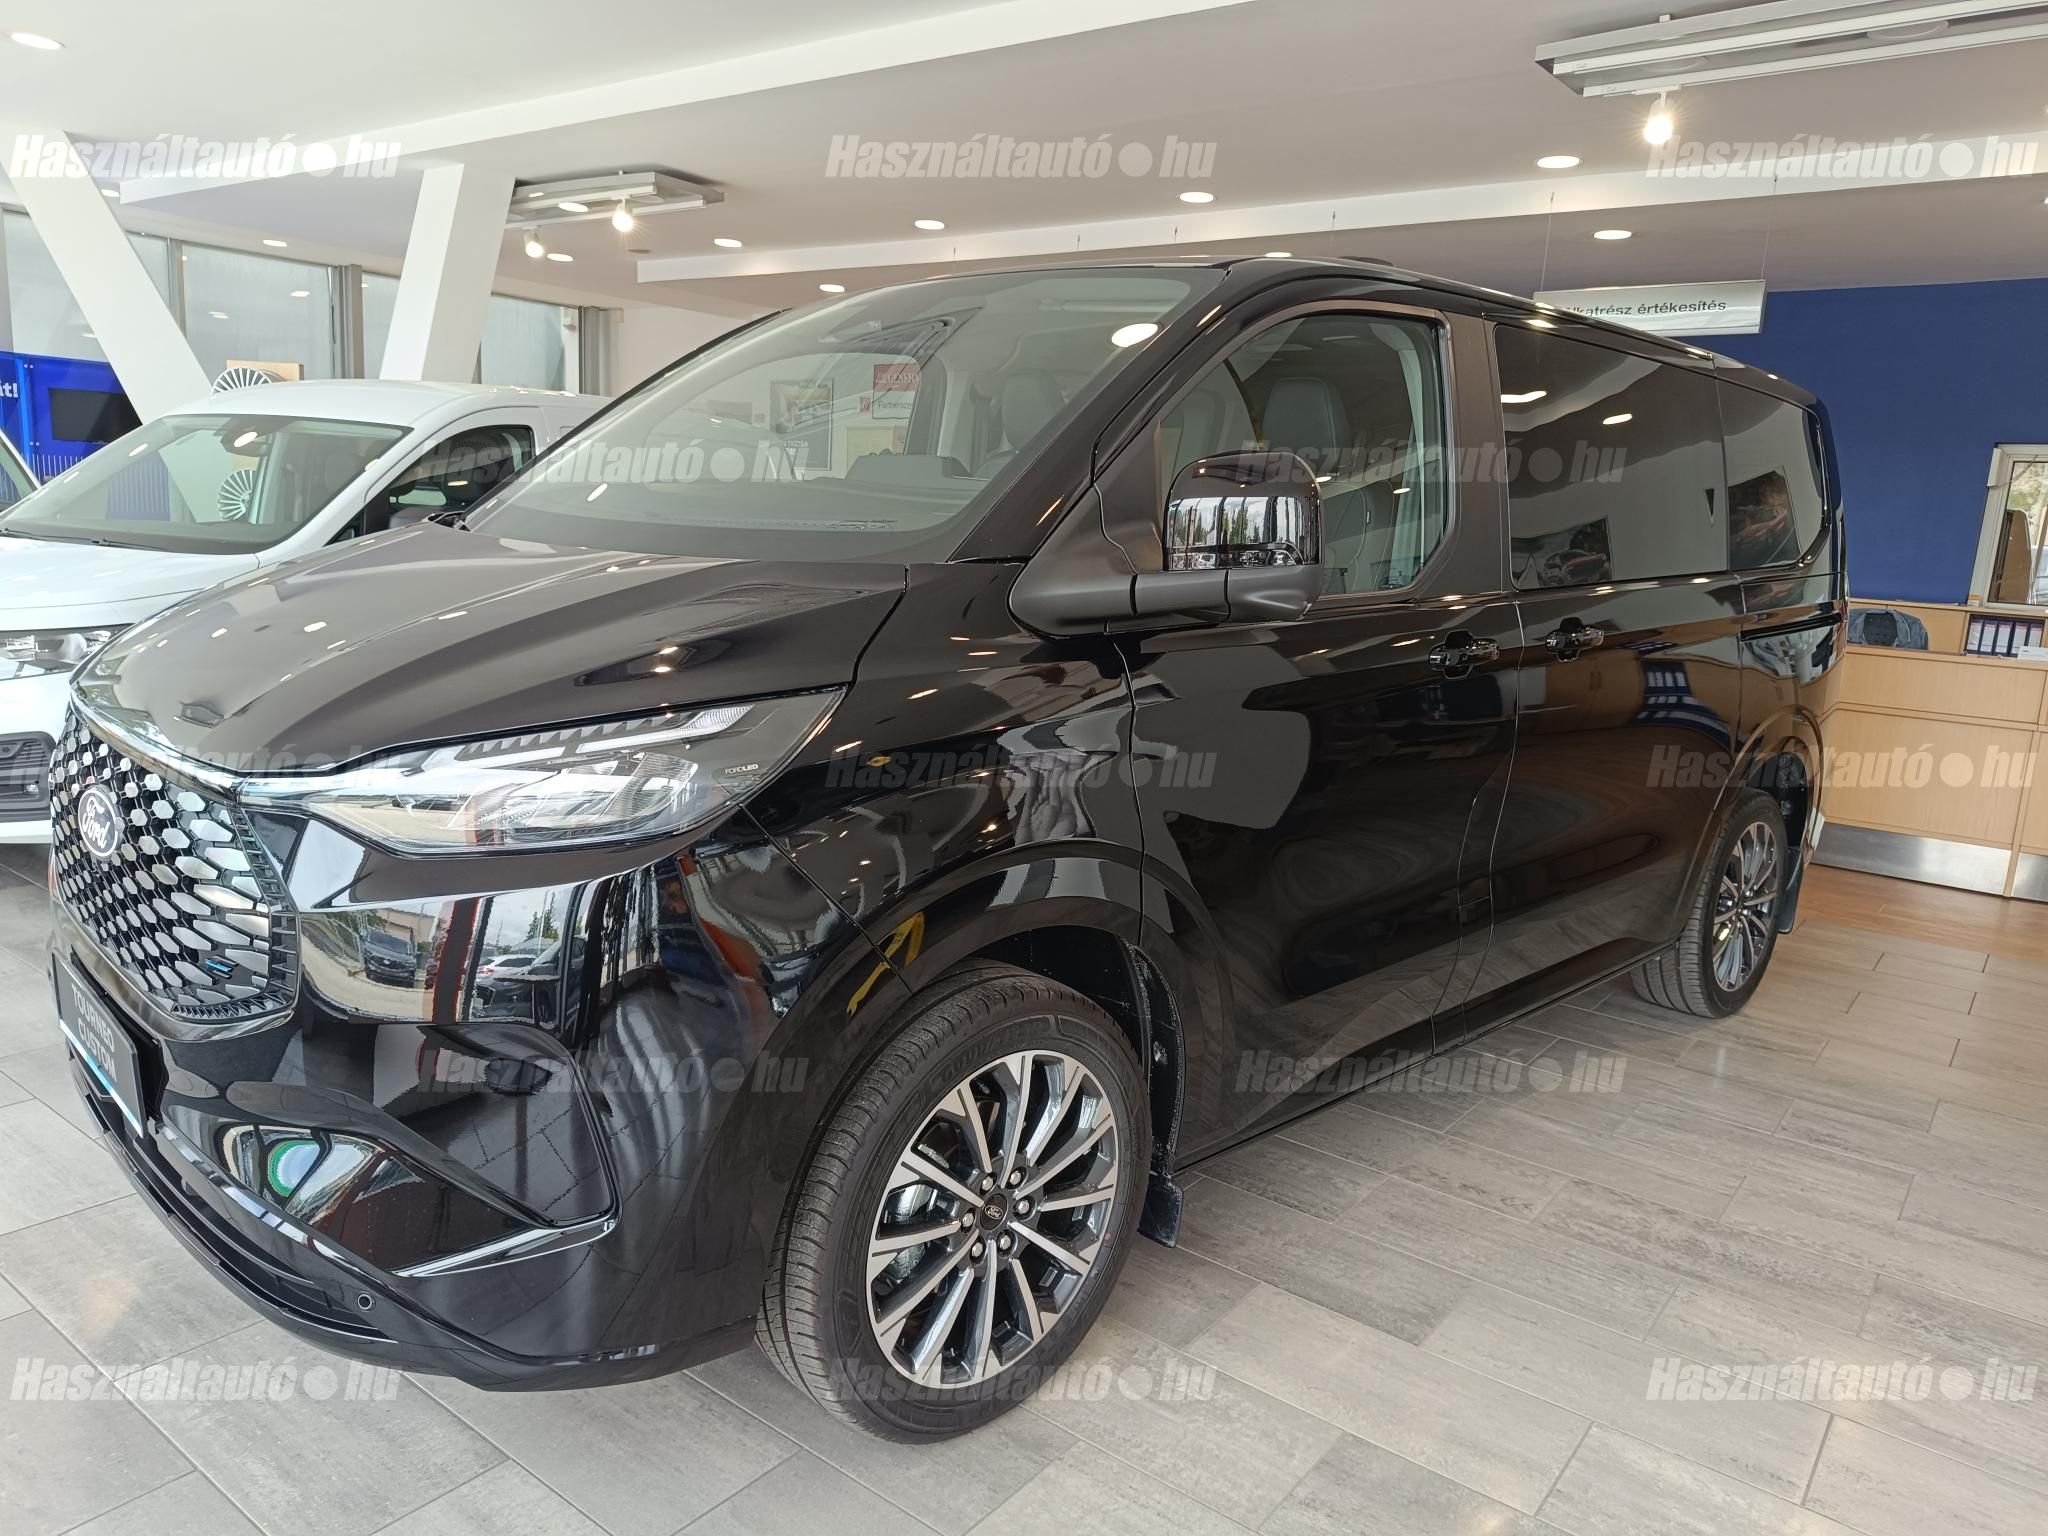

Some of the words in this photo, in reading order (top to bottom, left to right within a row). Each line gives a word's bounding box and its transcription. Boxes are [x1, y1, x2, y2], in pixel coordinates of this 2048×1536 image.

[1637, 300, 1727, 315] értékesítés
[82, 795, 112, 849] Ford
[71, 982, 115, 1053] TOURNEO
[77, 1018, 118, 1082] CUSTOM
